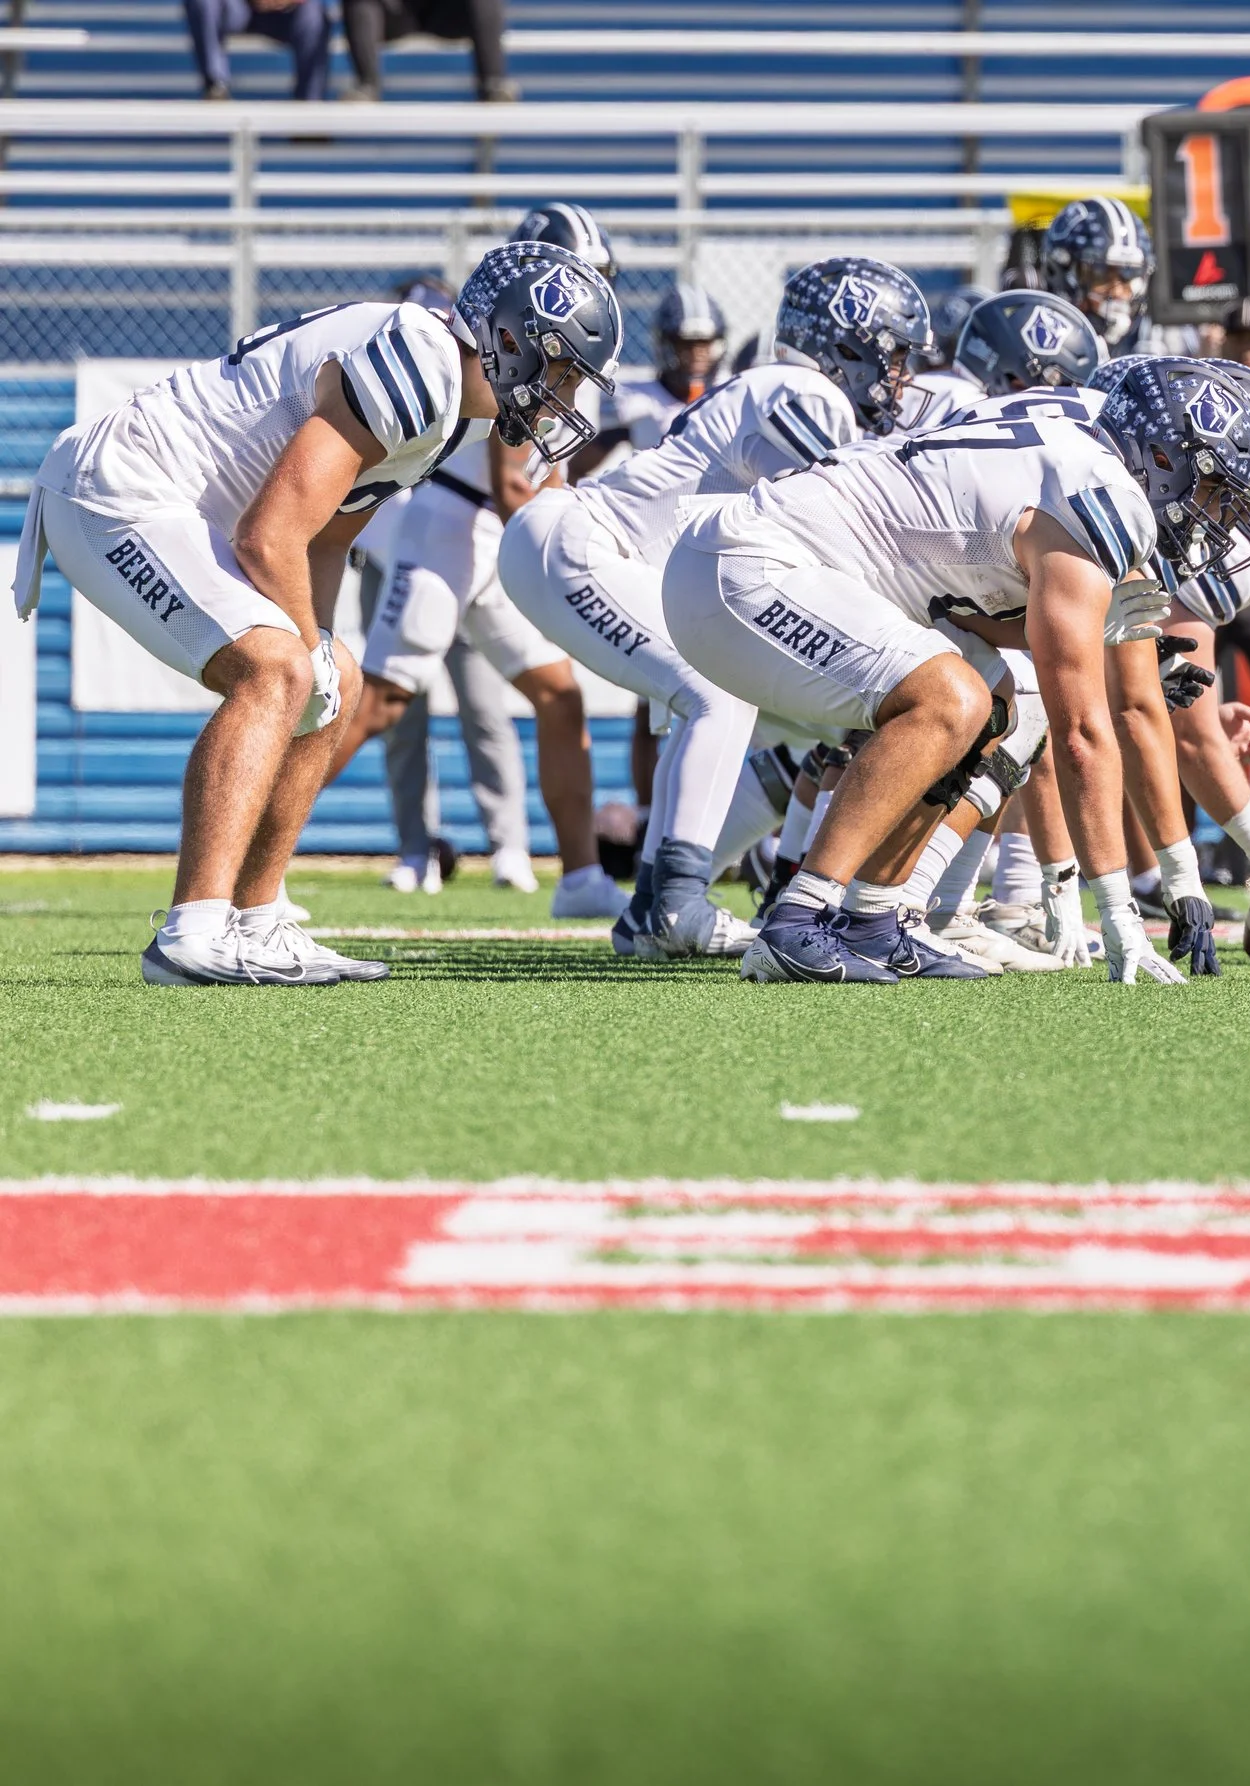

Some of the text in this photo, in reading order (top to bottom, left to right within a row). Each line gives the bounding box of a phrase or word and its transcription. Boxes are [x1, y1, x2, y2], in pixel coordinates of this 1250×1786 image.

[1175, 134, 1231, 247] 1
[105, 538, 185, 623] BERRY
[564, 585, 651, 657] BERRY
[753, 599, 848, 668] BERRY
